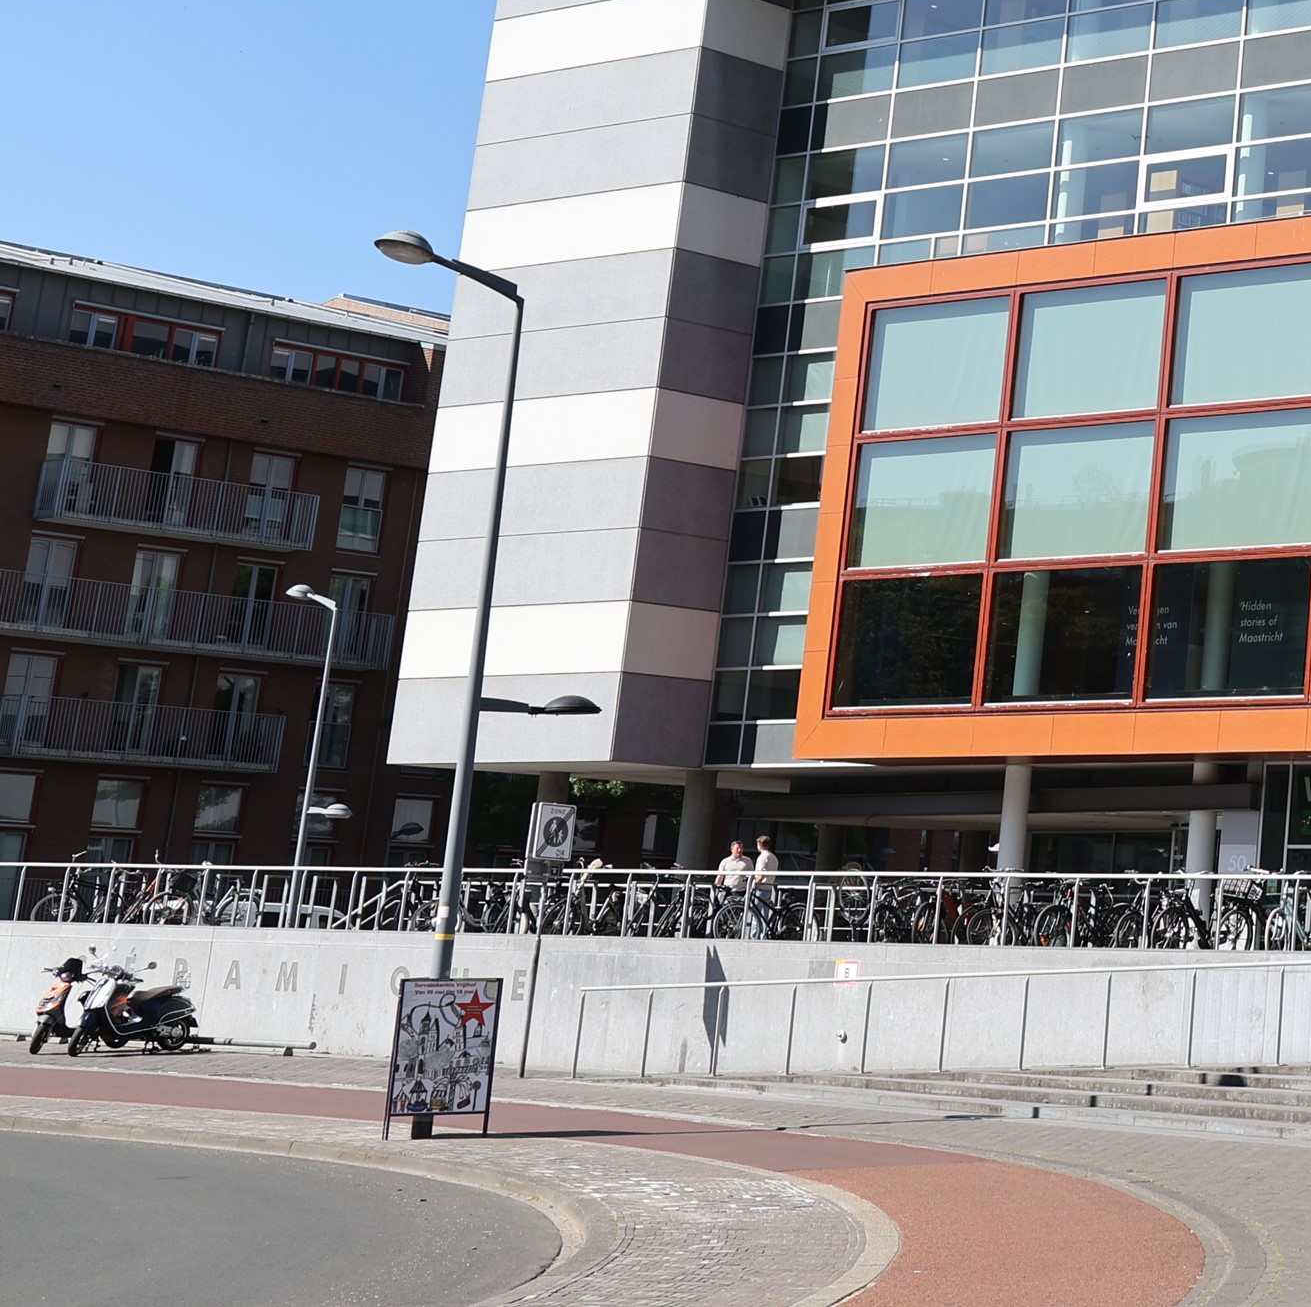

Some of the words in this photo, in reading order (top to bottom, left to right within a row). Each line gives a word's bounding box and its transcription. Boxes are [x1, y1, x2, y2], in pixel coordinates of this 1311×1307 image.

[1239, 617, 1266, 627] stories
[1268, 615, 1278, 626] of
[1238, 632, 1283, 643] Maastricht
[1227, 855, 1246, 872] 50
